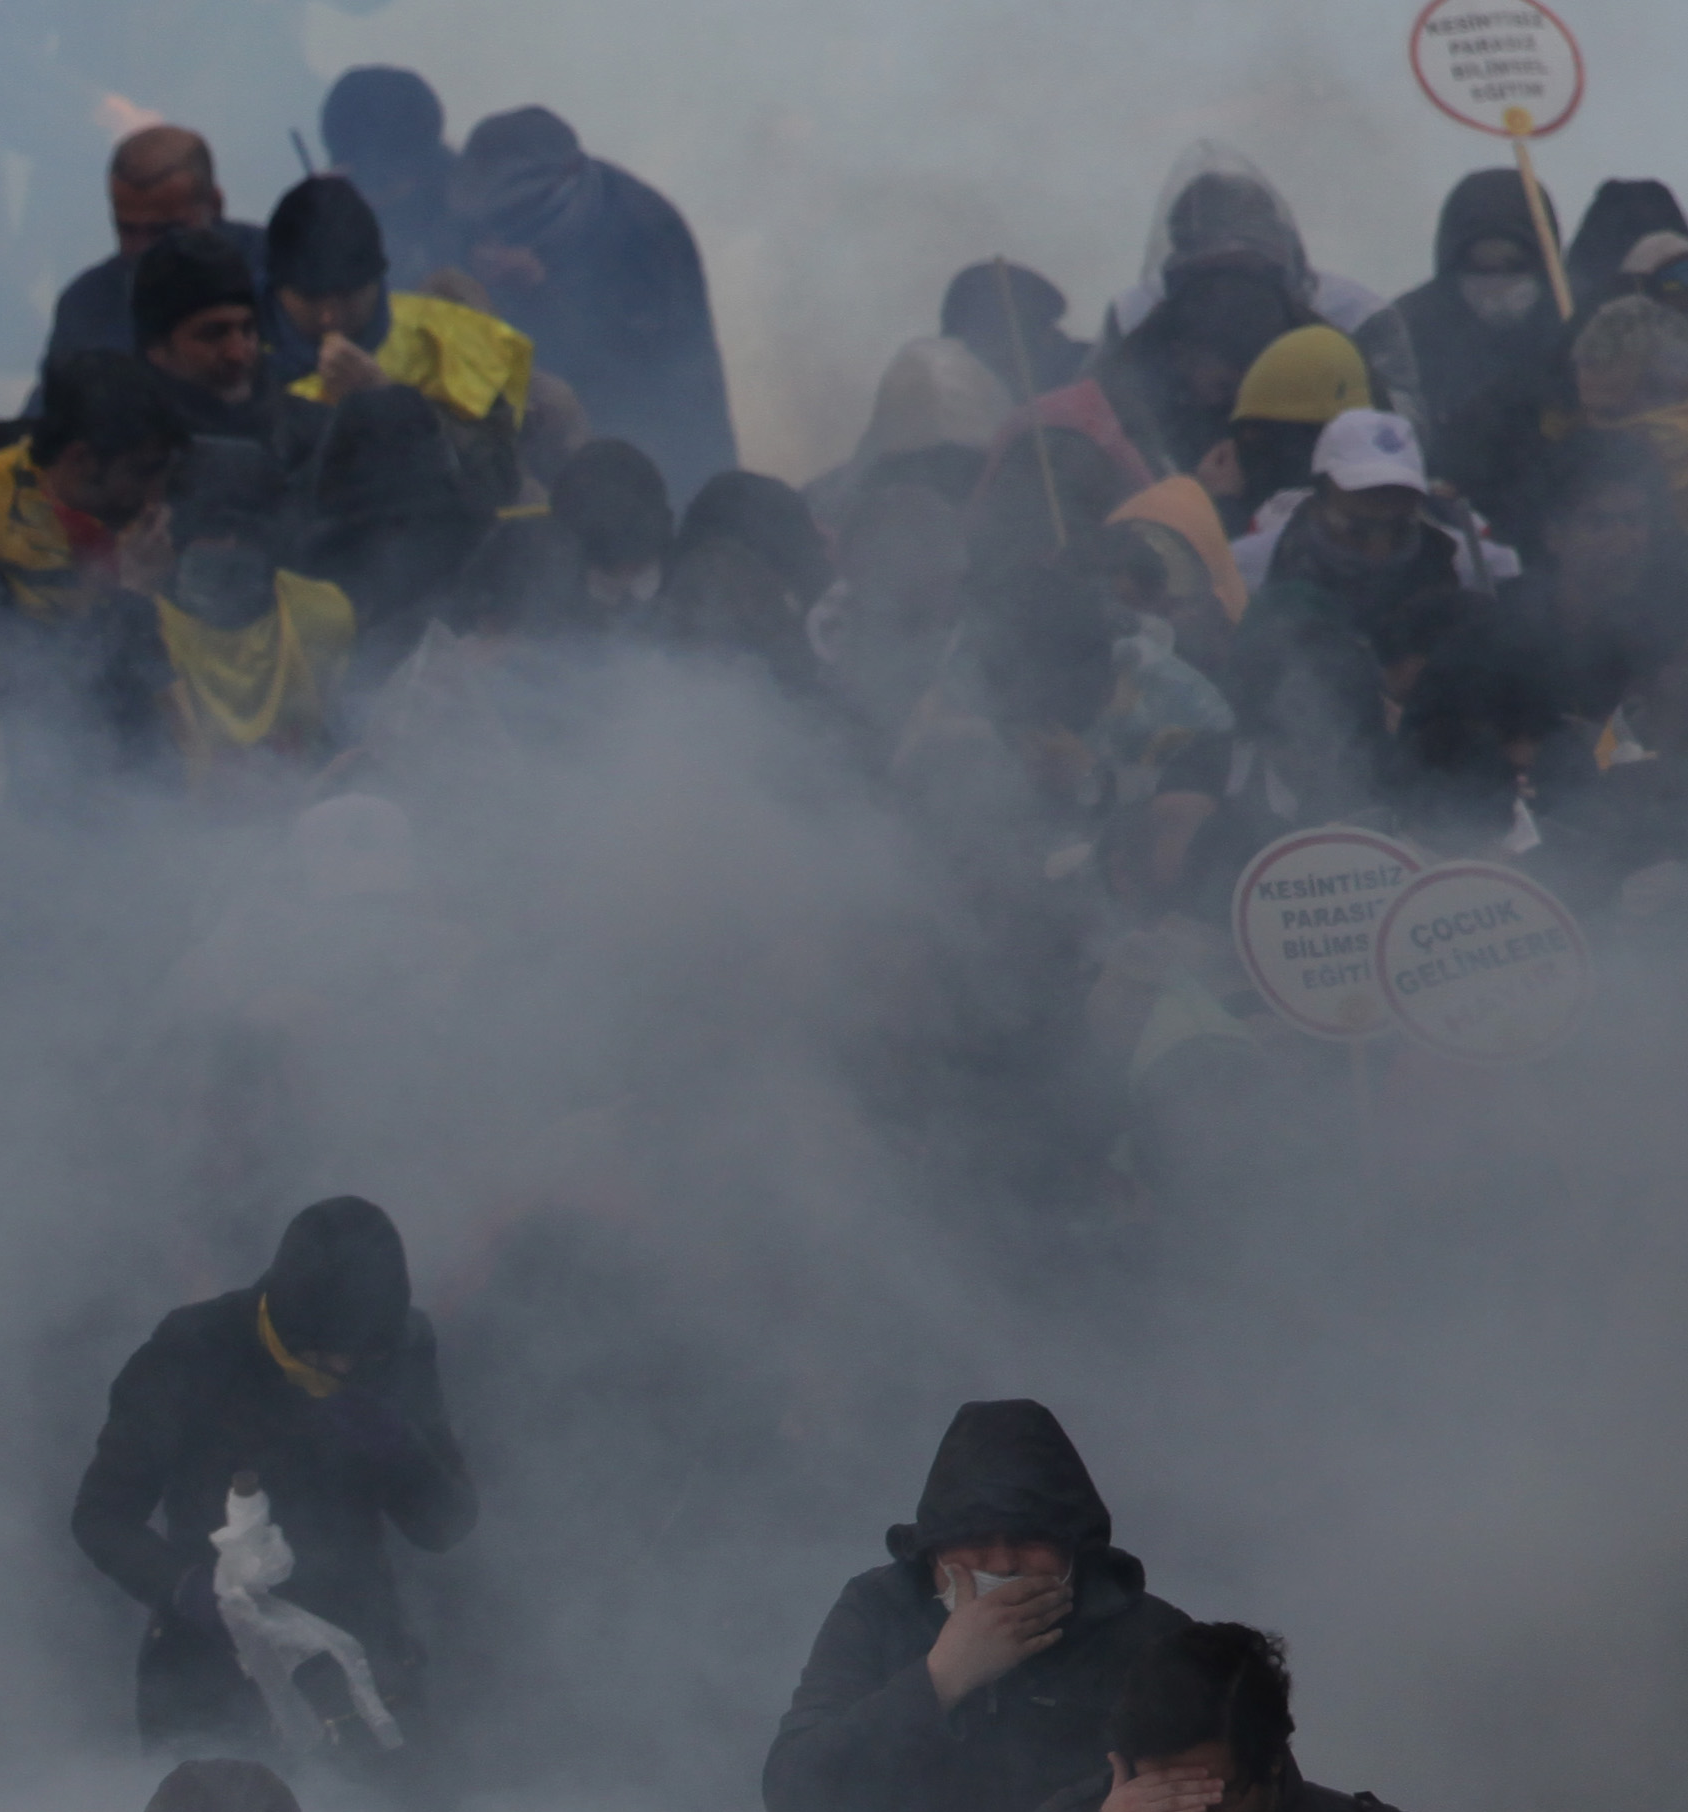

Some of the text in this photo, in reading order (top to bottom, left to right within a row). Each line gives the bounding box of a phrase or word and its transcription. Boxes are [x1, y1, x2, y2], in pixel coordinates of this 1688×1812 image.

[1257, 864, 1404, 901] KESİNTİSİZ
[1280, 899, 1386, 931] PARASI
[1409, 899, 1523, 955] ÇOCUK
[1282, 932, 1370, 961] BİLİMS
[1393, 926, 1568, 996] GELİNLERE
[1301, 963, 1371, 991] EĞİTİ
